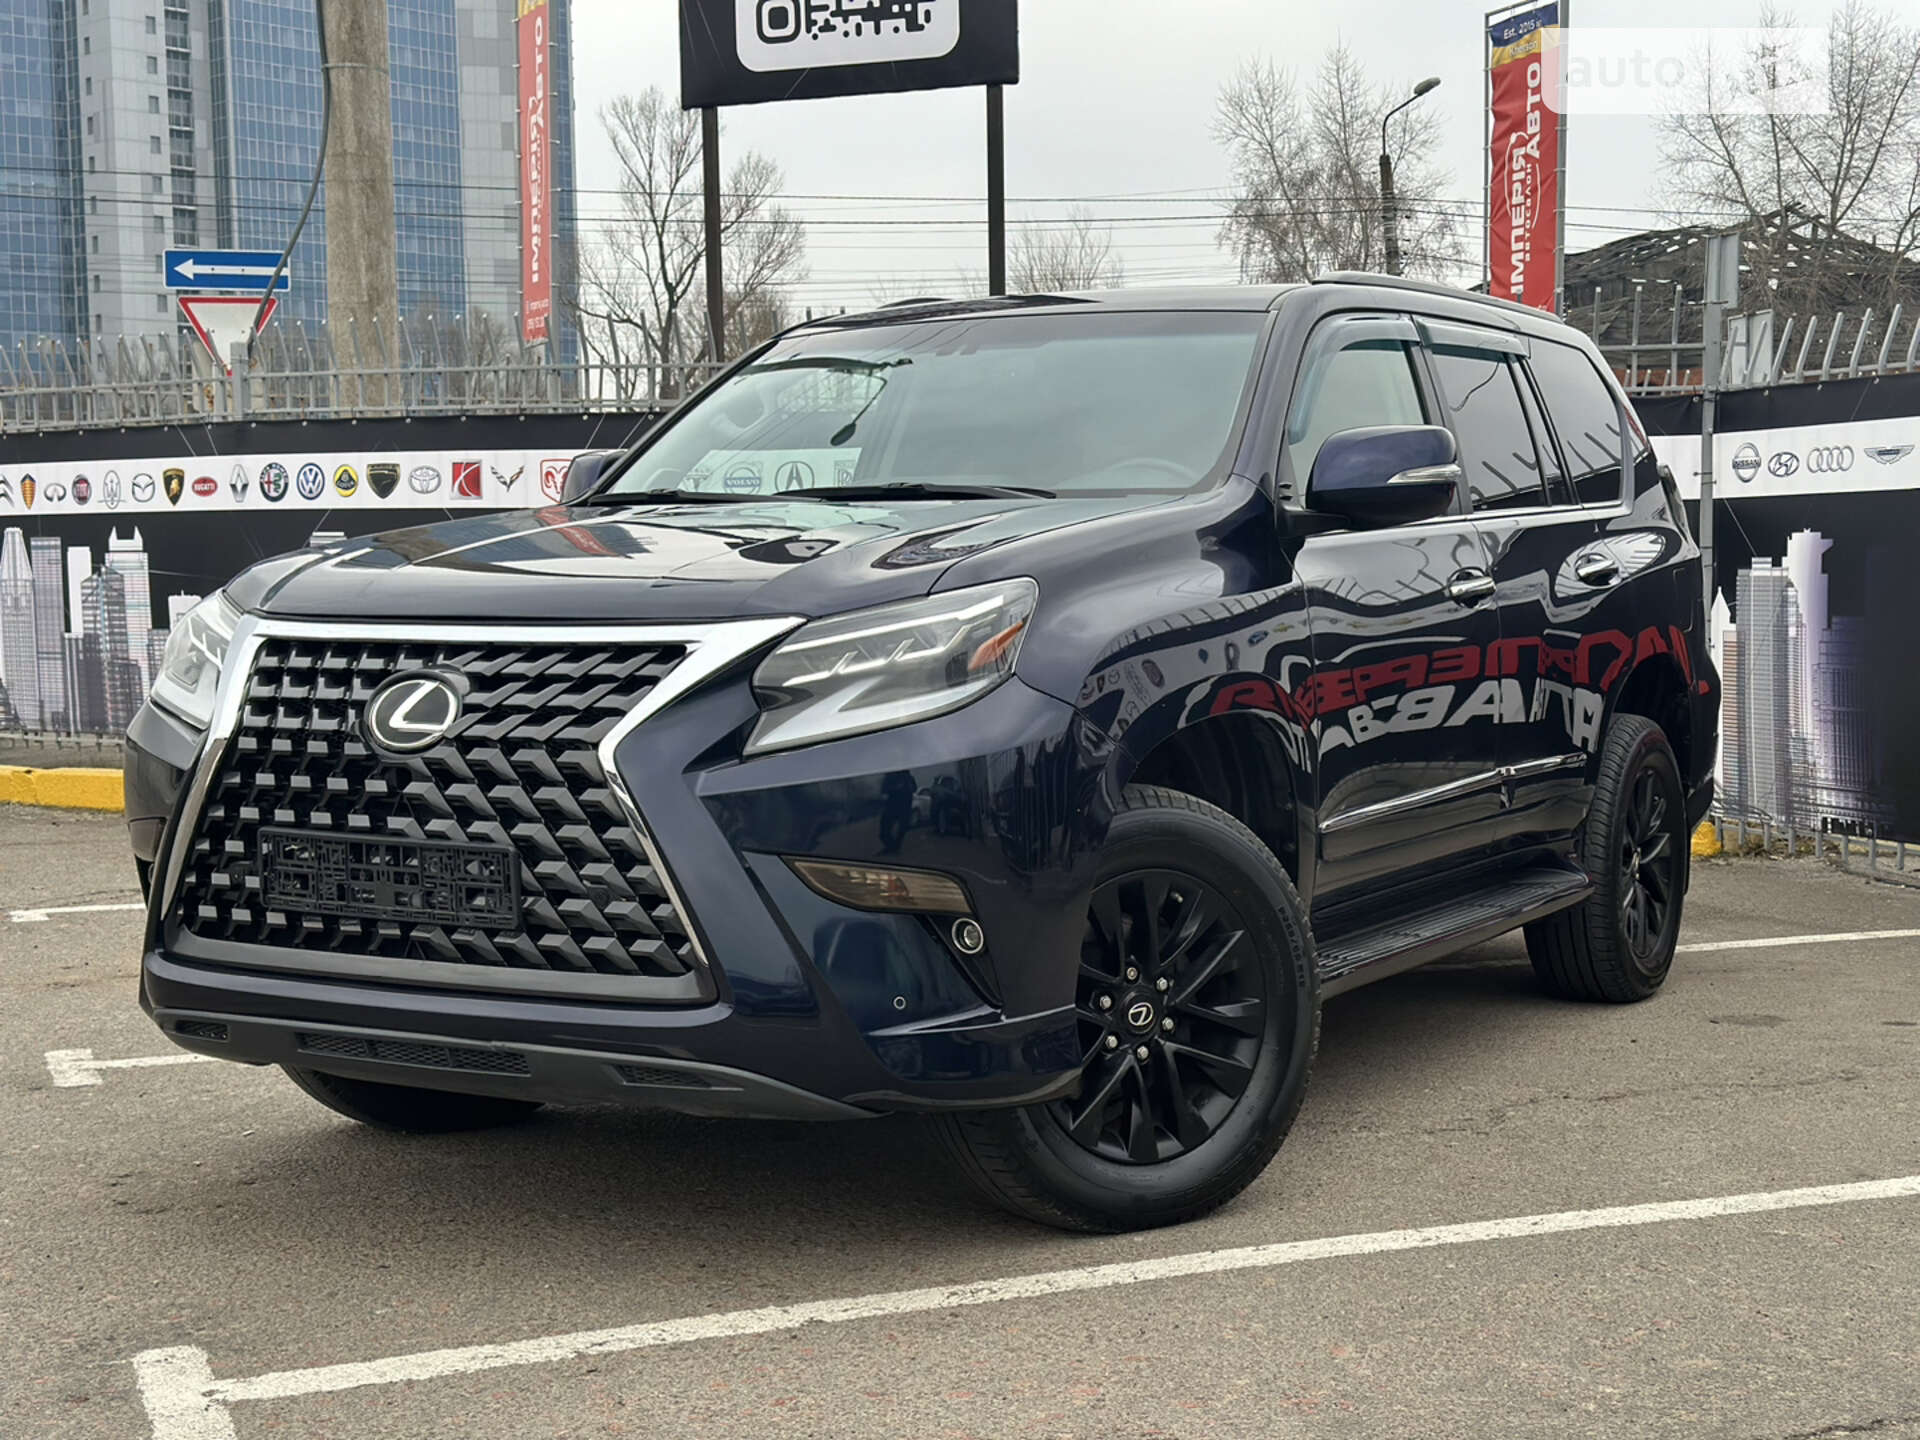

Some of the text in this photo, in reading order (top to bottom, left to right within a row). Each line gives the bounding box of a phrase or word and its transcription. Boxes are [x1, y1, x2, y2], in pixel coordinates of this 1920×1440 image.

[1503, 27, 1518, 40] Est.
[1518, 19, 1536, 35] 2015
[1510, 62, 1541, 295] ІМПЕРІЯ АВТО
[725, 478, 760, 488] VOLVO
